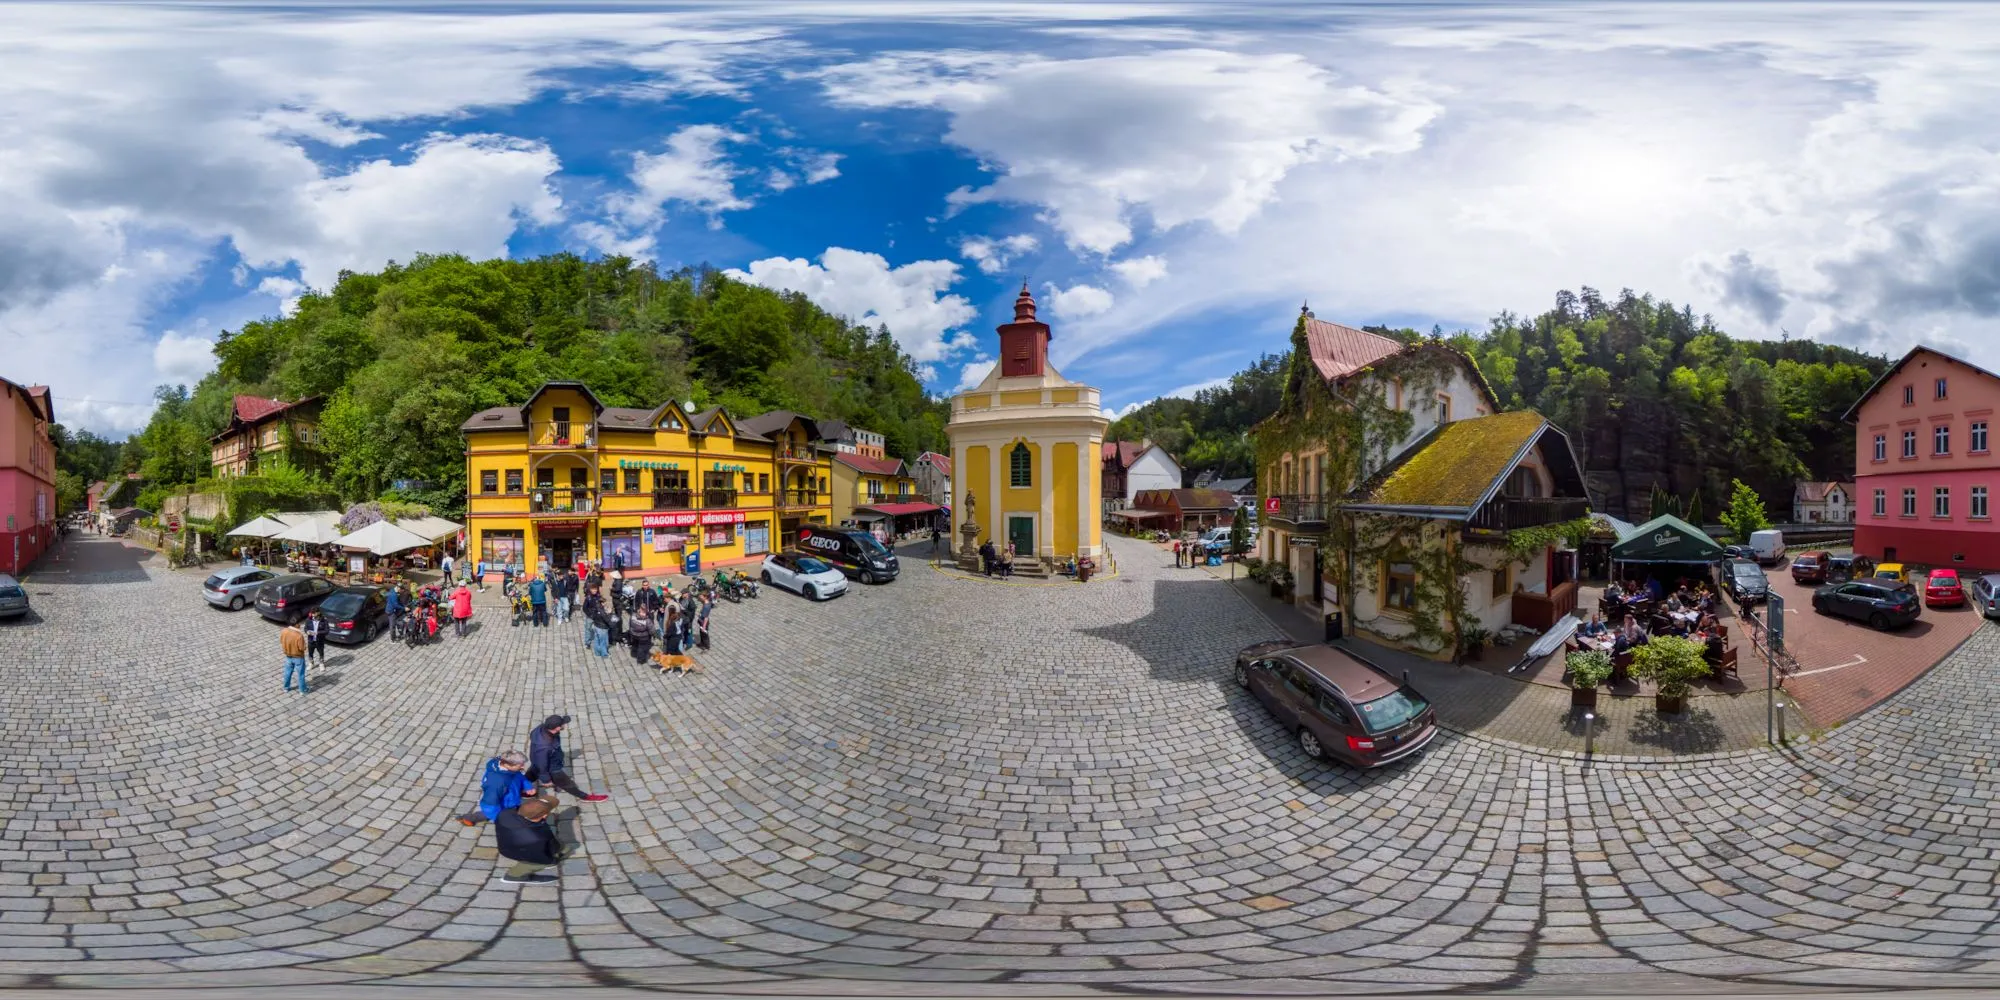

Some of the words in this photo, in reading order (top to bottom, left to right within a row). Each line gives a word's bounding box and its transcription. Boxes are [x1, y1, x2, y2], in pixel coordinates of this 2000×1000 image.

[643, 515, 675, 525] DRAGON
[676, 514, 696, 524] SHOP
[702, 513, 732, 524] HŘENSKO
[810, 536, 840, 551] GECO
